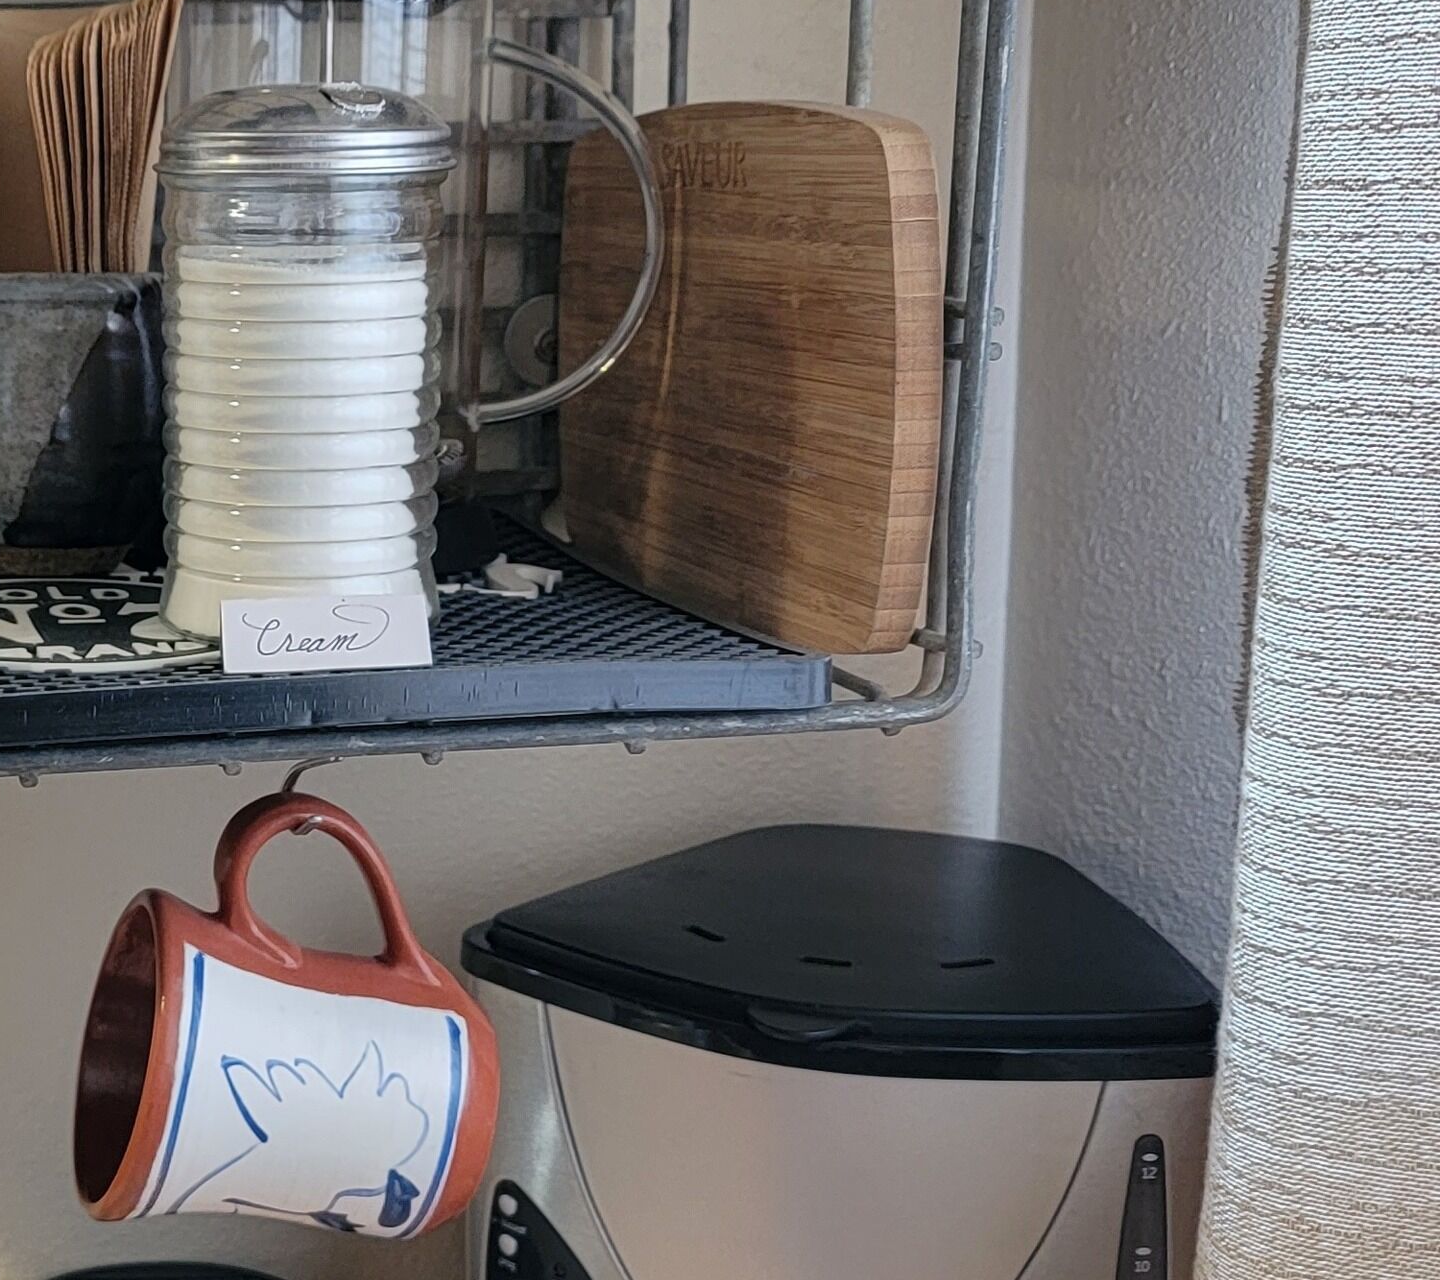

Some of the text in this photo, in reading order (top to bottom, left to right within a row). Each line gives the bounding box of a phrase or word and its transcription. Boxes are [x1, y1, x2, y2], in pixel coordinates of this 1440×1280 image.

[661, 141, 747, 189] SAVEUR
[242, 604, 390, 656] Cream
[1142, 1167, 1158, 1180] 12
[1134, 1260, 1151, 1273] 10
